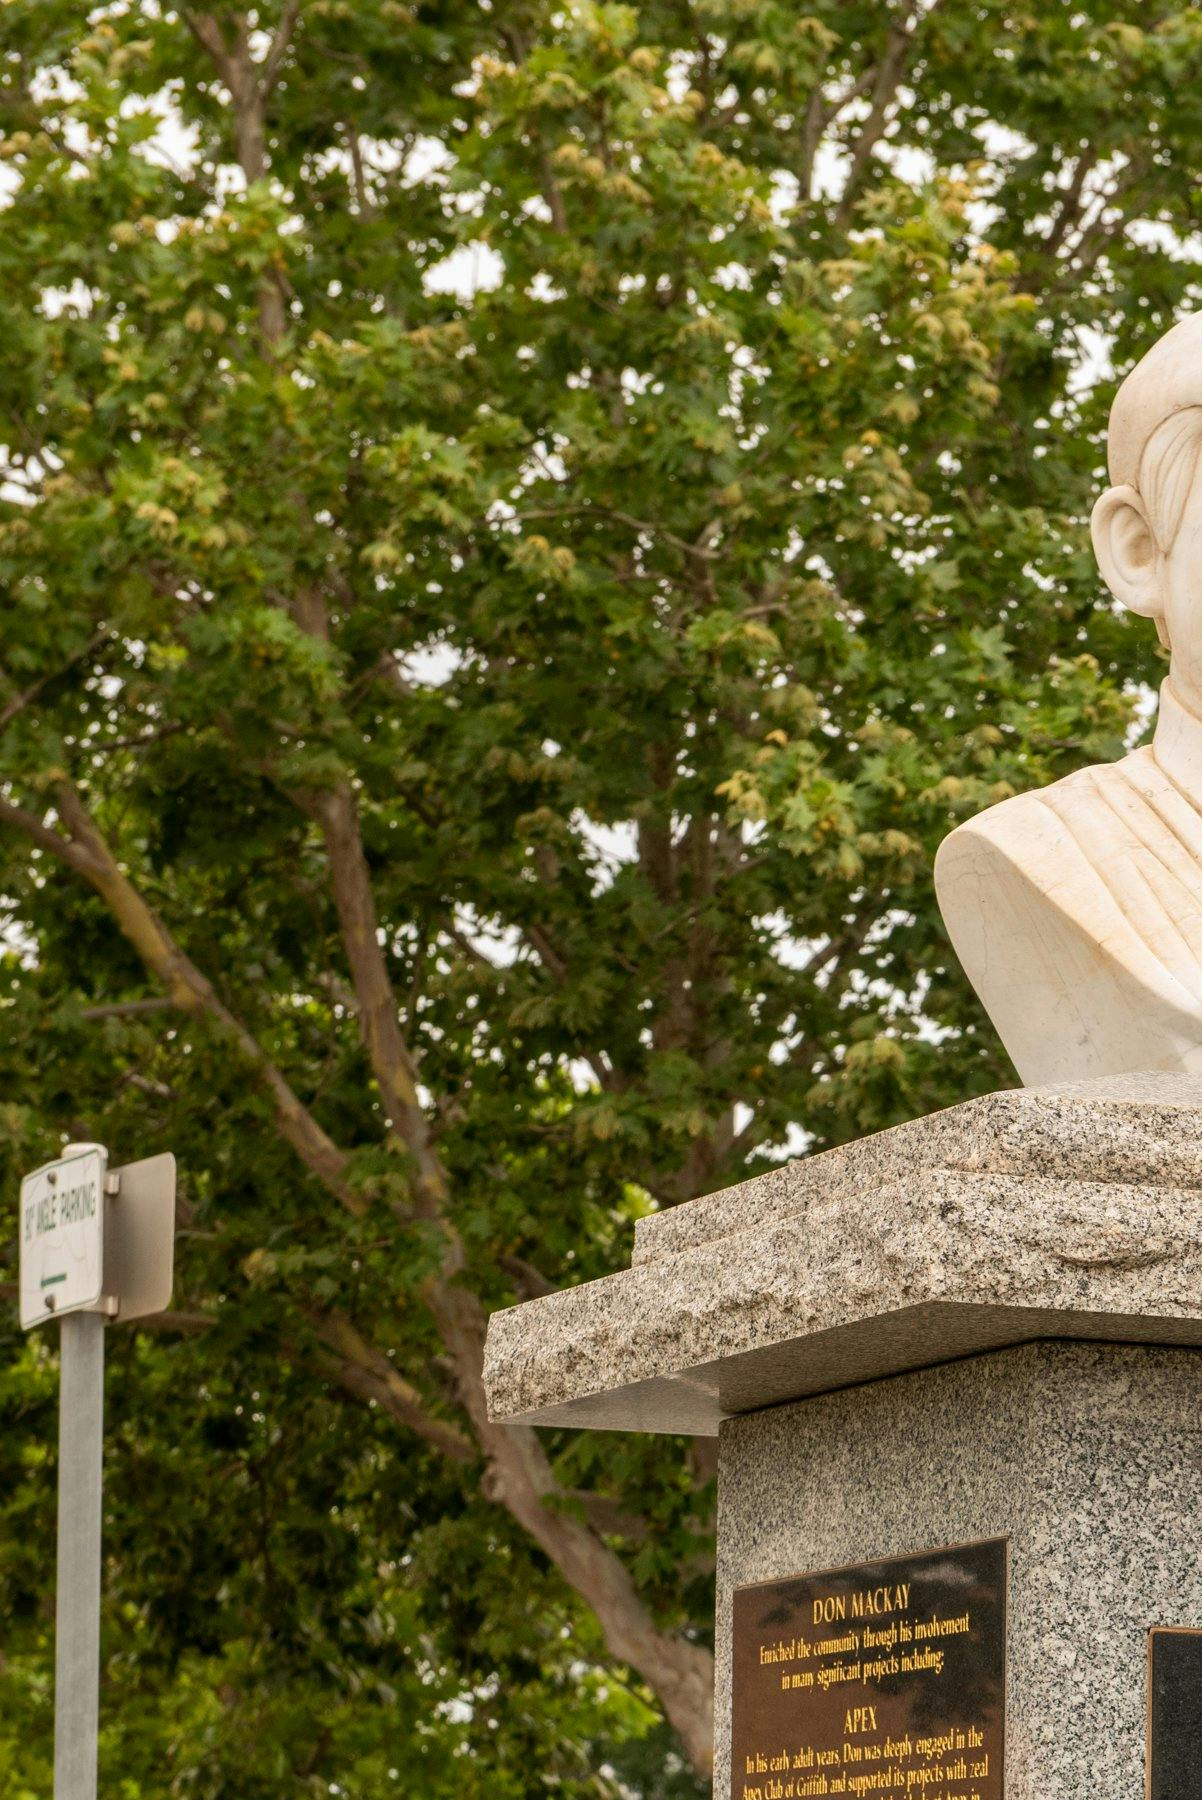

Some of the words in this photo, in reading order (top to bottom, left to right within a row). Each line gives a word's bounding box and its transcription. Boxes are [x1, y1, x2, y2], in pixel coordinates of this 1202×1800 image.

[813, 1595, 845, 1624] DON
[851, 1584, 910, 1618] MACKAY
[759, 1640, 795, 1665] Enriched
[796, 1638, 811, 1659] the
[813, 1631, 859, 1657] community
[862, 1624, 897, 1651] through
[899, 1622, 912, 1643] his
[914, 1614, 969, 1641] involvement
[781, 1671, 790, 1691] in
[791, 1672, 813, 1693] many
[816, 1662, 860, 1690] significant
[862, 1657, 899, 1685] projects
[900, 1649, 944, 1674] including:
[843, 1706, 877, 1734] APEX
[745, 1755, 754, 1775] In
[755, 1753, 767, 1773] his
[769, 1751, 789, 1775] early
[792, 1748, 814, 1769] adult
[816, 1750, 840, 1772] years,
[842, 1743, 862, 1763] Don
[863, 1745, 881, 1761] was
[883, 1736, 912, 1763] deeply
[915, 1730, 954, 1759] engaged
[955, 1730, 965, 1750] in
[967, 1727, 983, 1749] the
[764, 1779, 783, 1800] Club
[784, 1778, 794, 1798] of
[796, 1774, 828, 1797] Griffith
[829, 1772, 846, 1793] and
[847, 1767, 891, 1796] supported
[893, 1766, 905, 1787] its
[906, 1763, 943, 1791] projects
[945, 1759, 966, 1781] with
[969, 1756, 988, 1779] zeal
